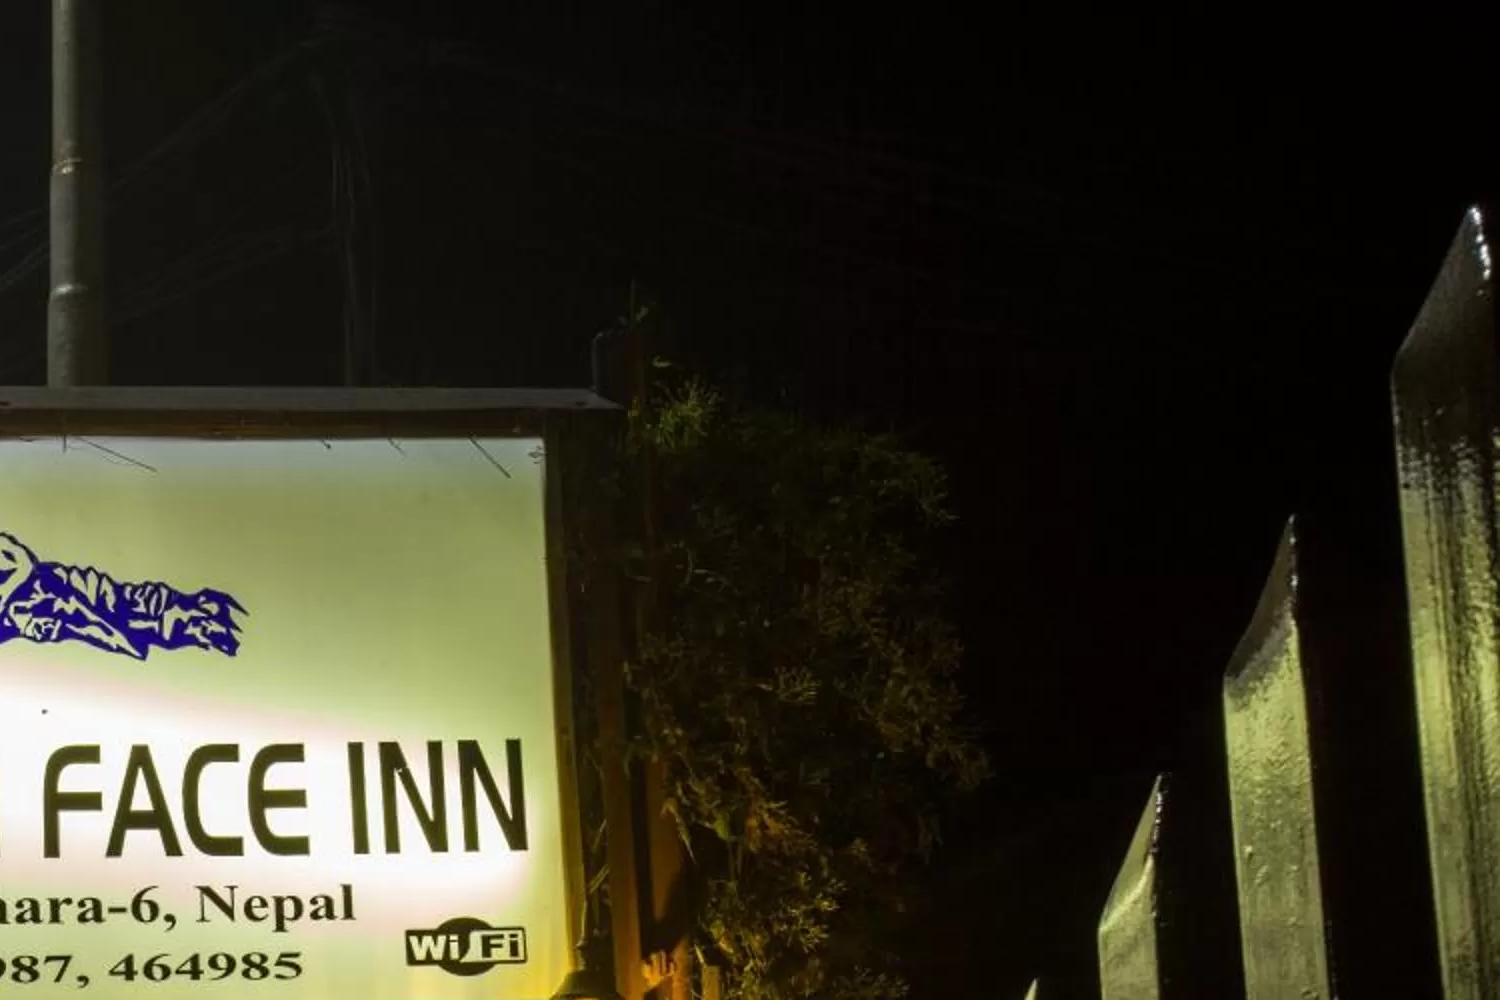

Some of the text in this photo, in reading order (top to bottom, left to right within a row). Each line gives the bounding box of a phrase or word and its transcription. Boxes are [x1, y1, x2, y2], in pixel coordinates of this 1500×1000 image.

[44, 744, 311, 858] FACE
[348, 739, 529, 855] INN
[195, 884, 356, 933] Nepal
[108, 952, 303, 982] 464985
